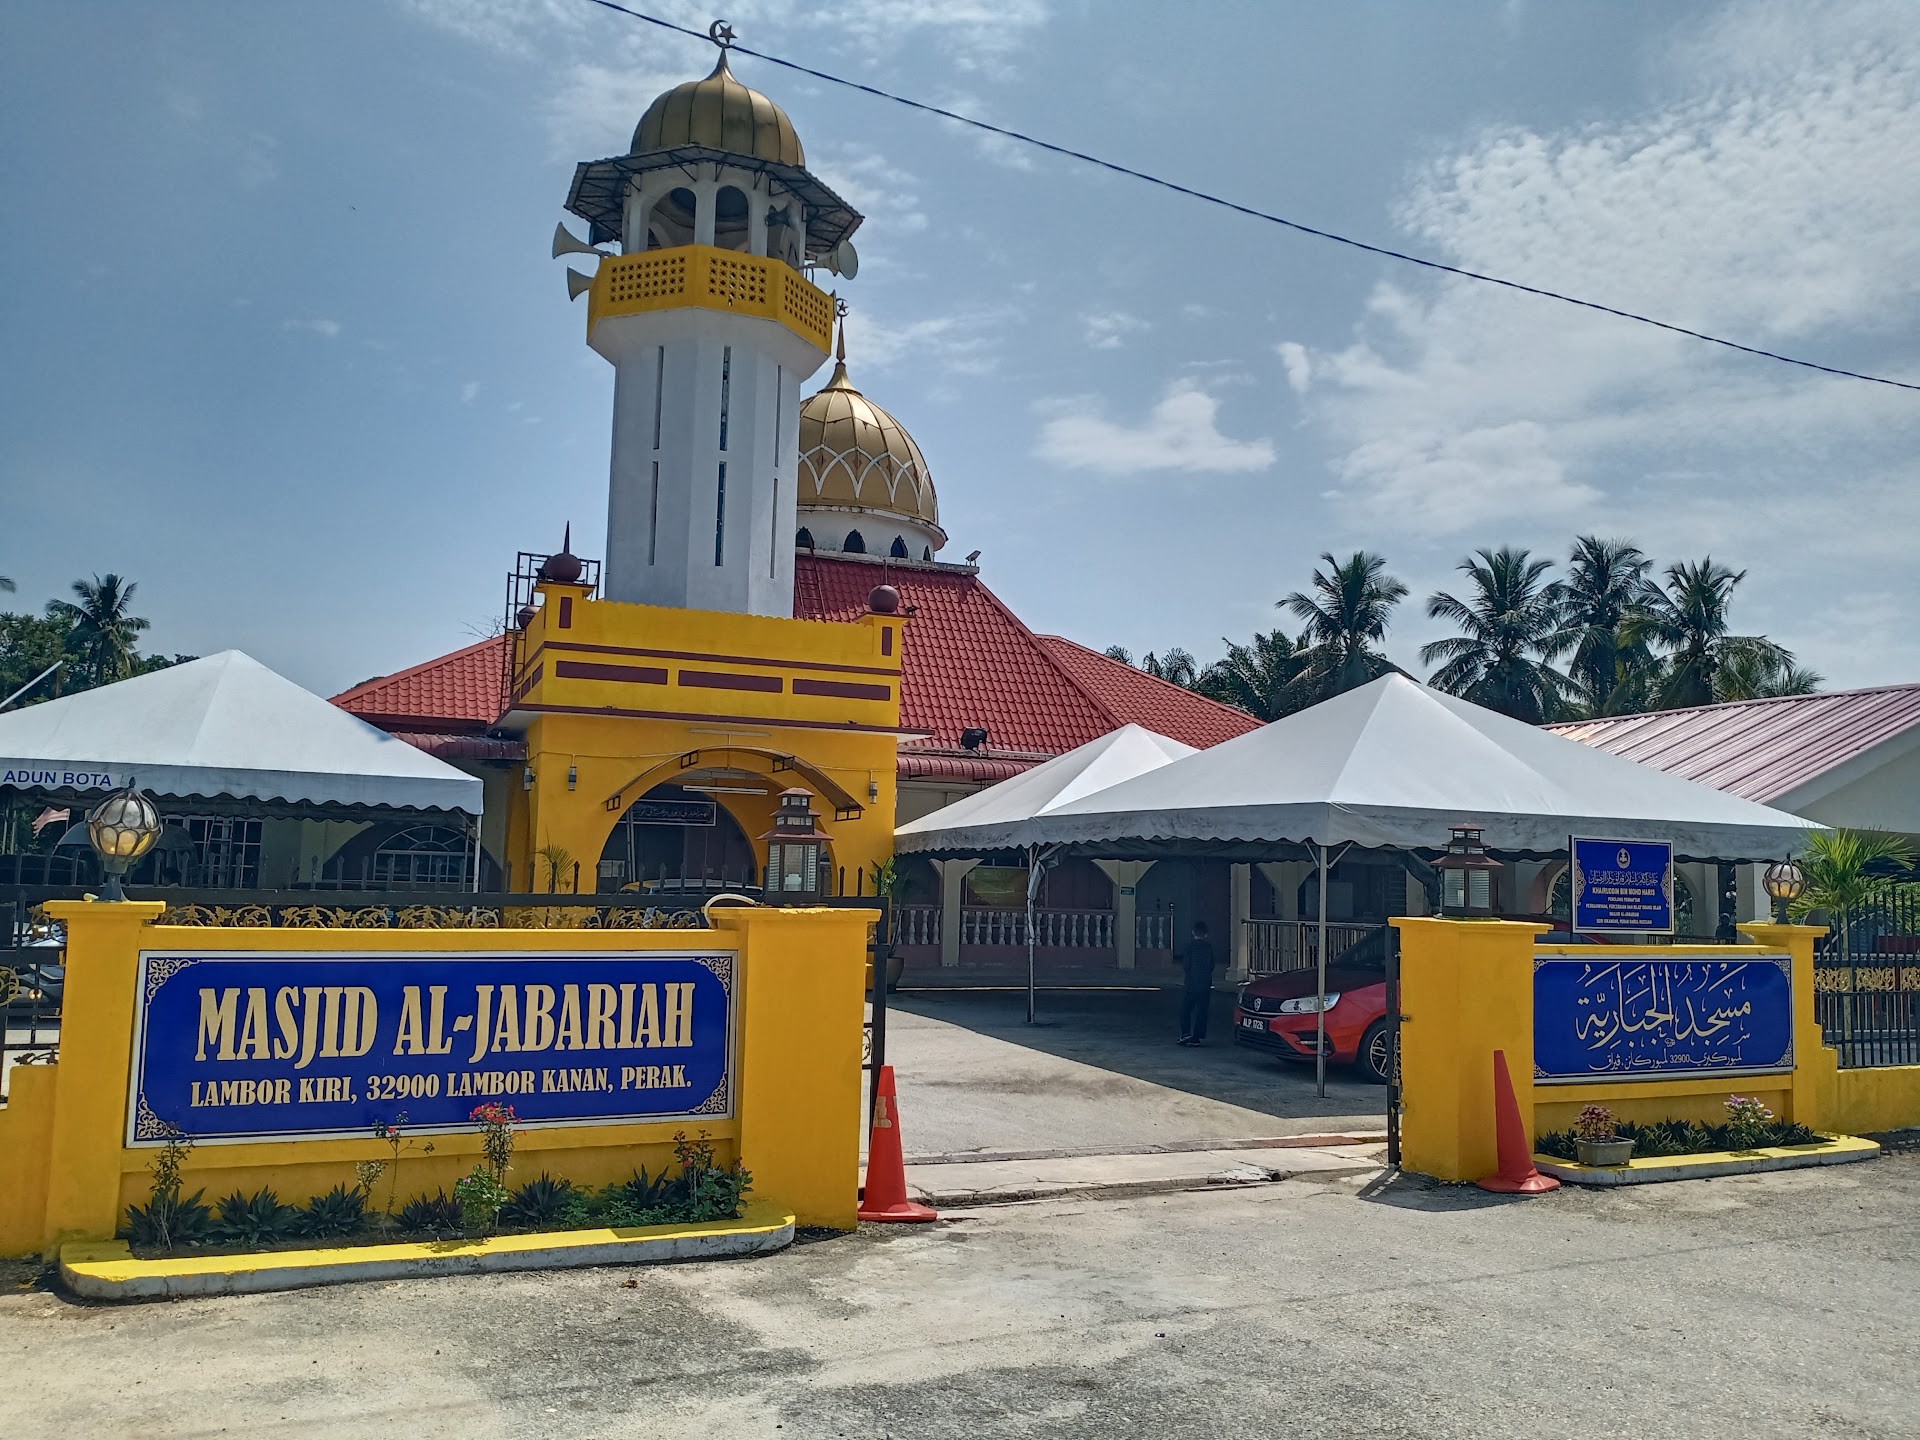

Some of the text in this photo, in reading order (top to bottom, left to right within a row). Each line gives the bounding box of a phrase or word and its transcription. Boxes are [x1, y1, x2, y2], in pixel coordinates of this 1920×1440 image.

[3, 770, 112, 787] ADUN BOTA
[194, 983, 696, 1070] MASJID AL-JABARIAH
[1669, 1054, 1690, 1064] 32900
[190, 1064, 693, 1108] LAMBOR KIRI, 32900 LAMBOR KANAN, PERAK.
